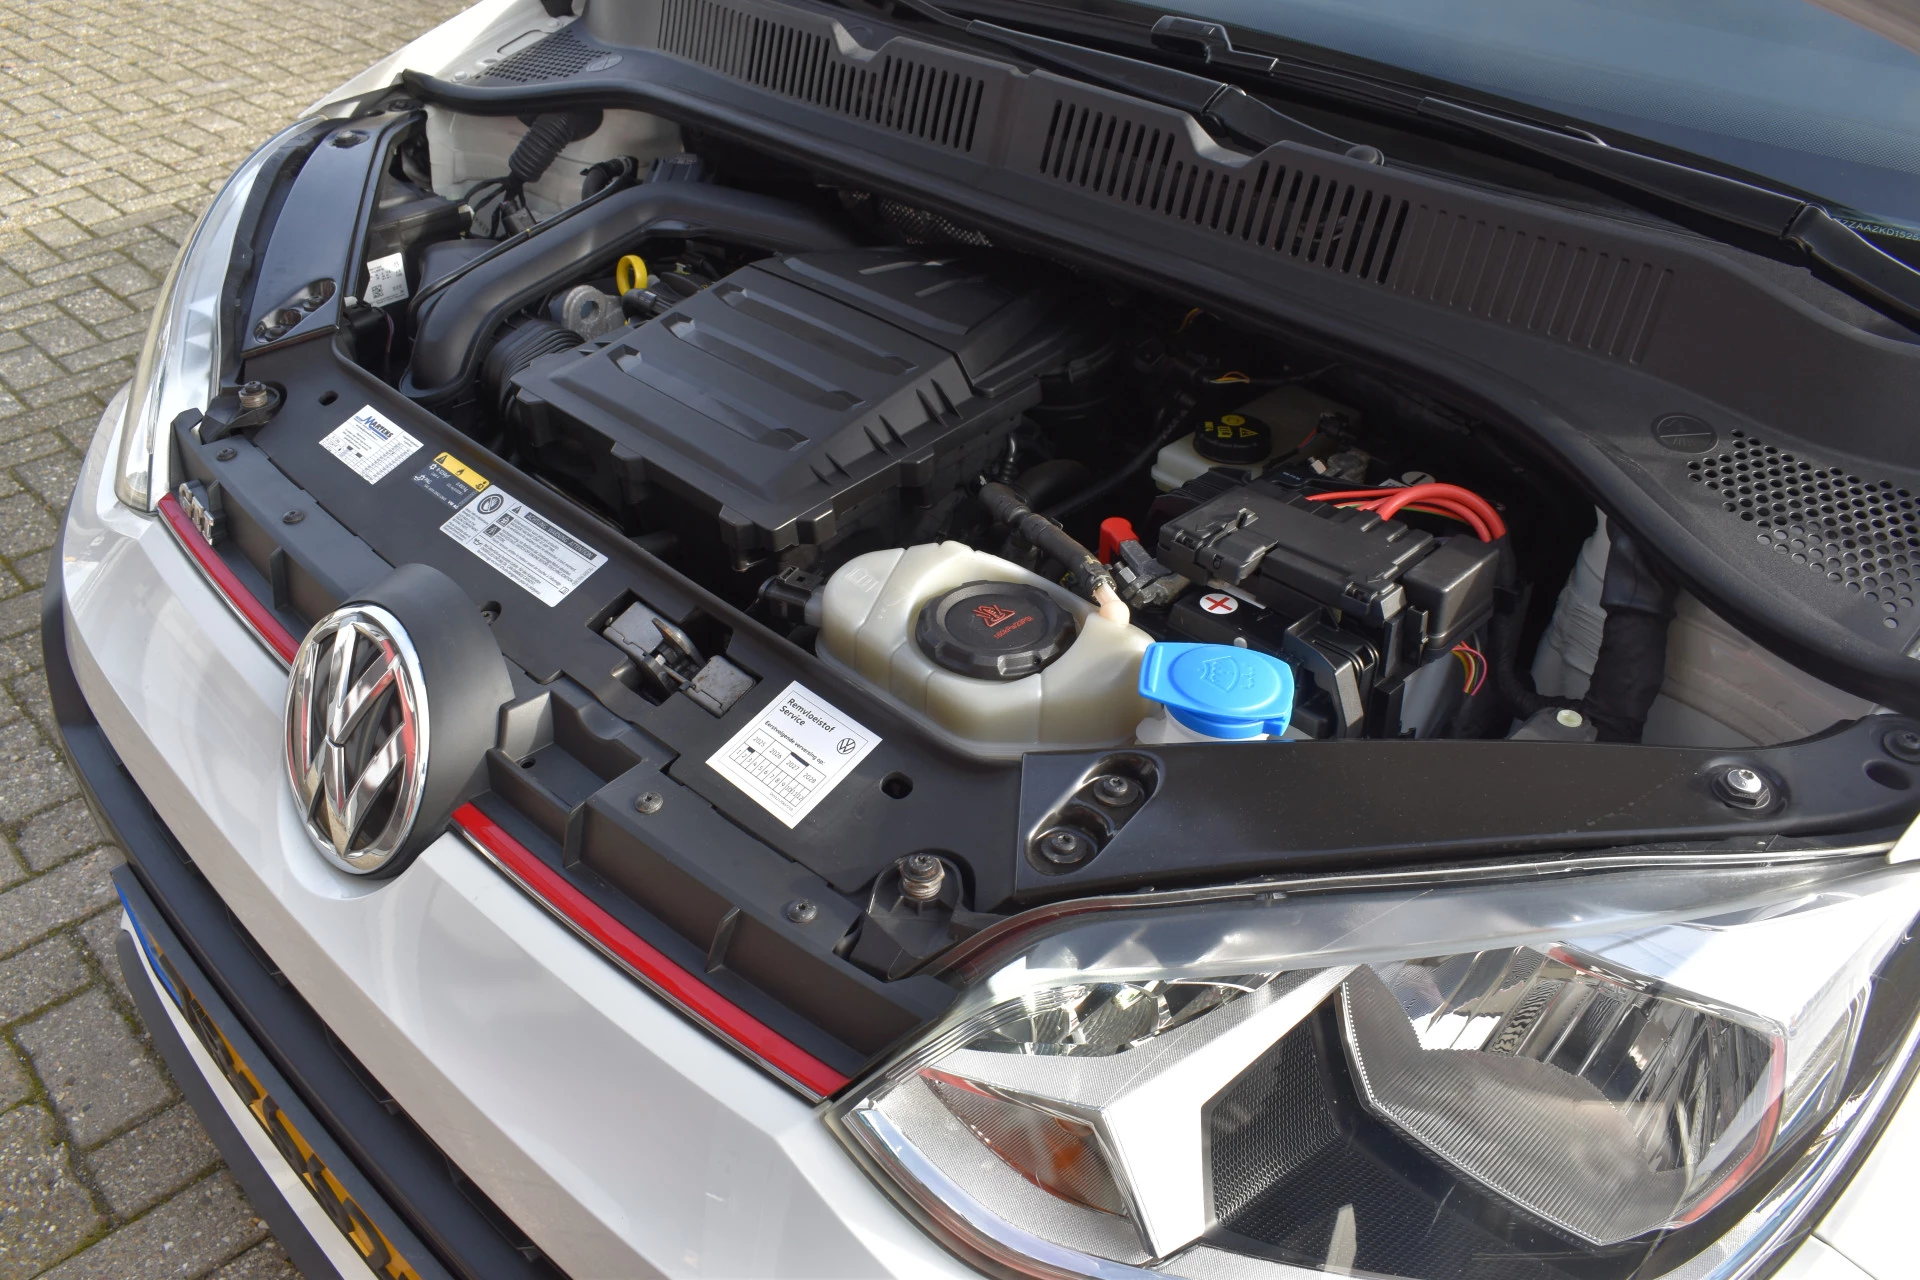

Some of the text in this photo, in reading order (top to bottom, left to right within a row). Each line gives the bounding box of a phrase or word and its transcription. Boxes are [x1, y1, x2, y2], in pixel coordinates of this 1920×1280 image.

[1838, 218, 1920, 241] ZZAAZKD1525
[362, 415, 394, 438] MARTENS
[526, 513, 548, 529] ACHTUNG
[547, 526, 570, 543] WARNING
[568, 540, 594, 558] ATTENTION
[779, 705, 806, 726] Service
[787, 697, 836, 733] Remvloeistof
[753, 736, 766, 747] 2025
[769, 748, 782, 759] 2026
[785, 760, 800, 771] 2027
[764, 720, 795, 744] Eerstvolgende
[794, 741, 817, 760] verversing
